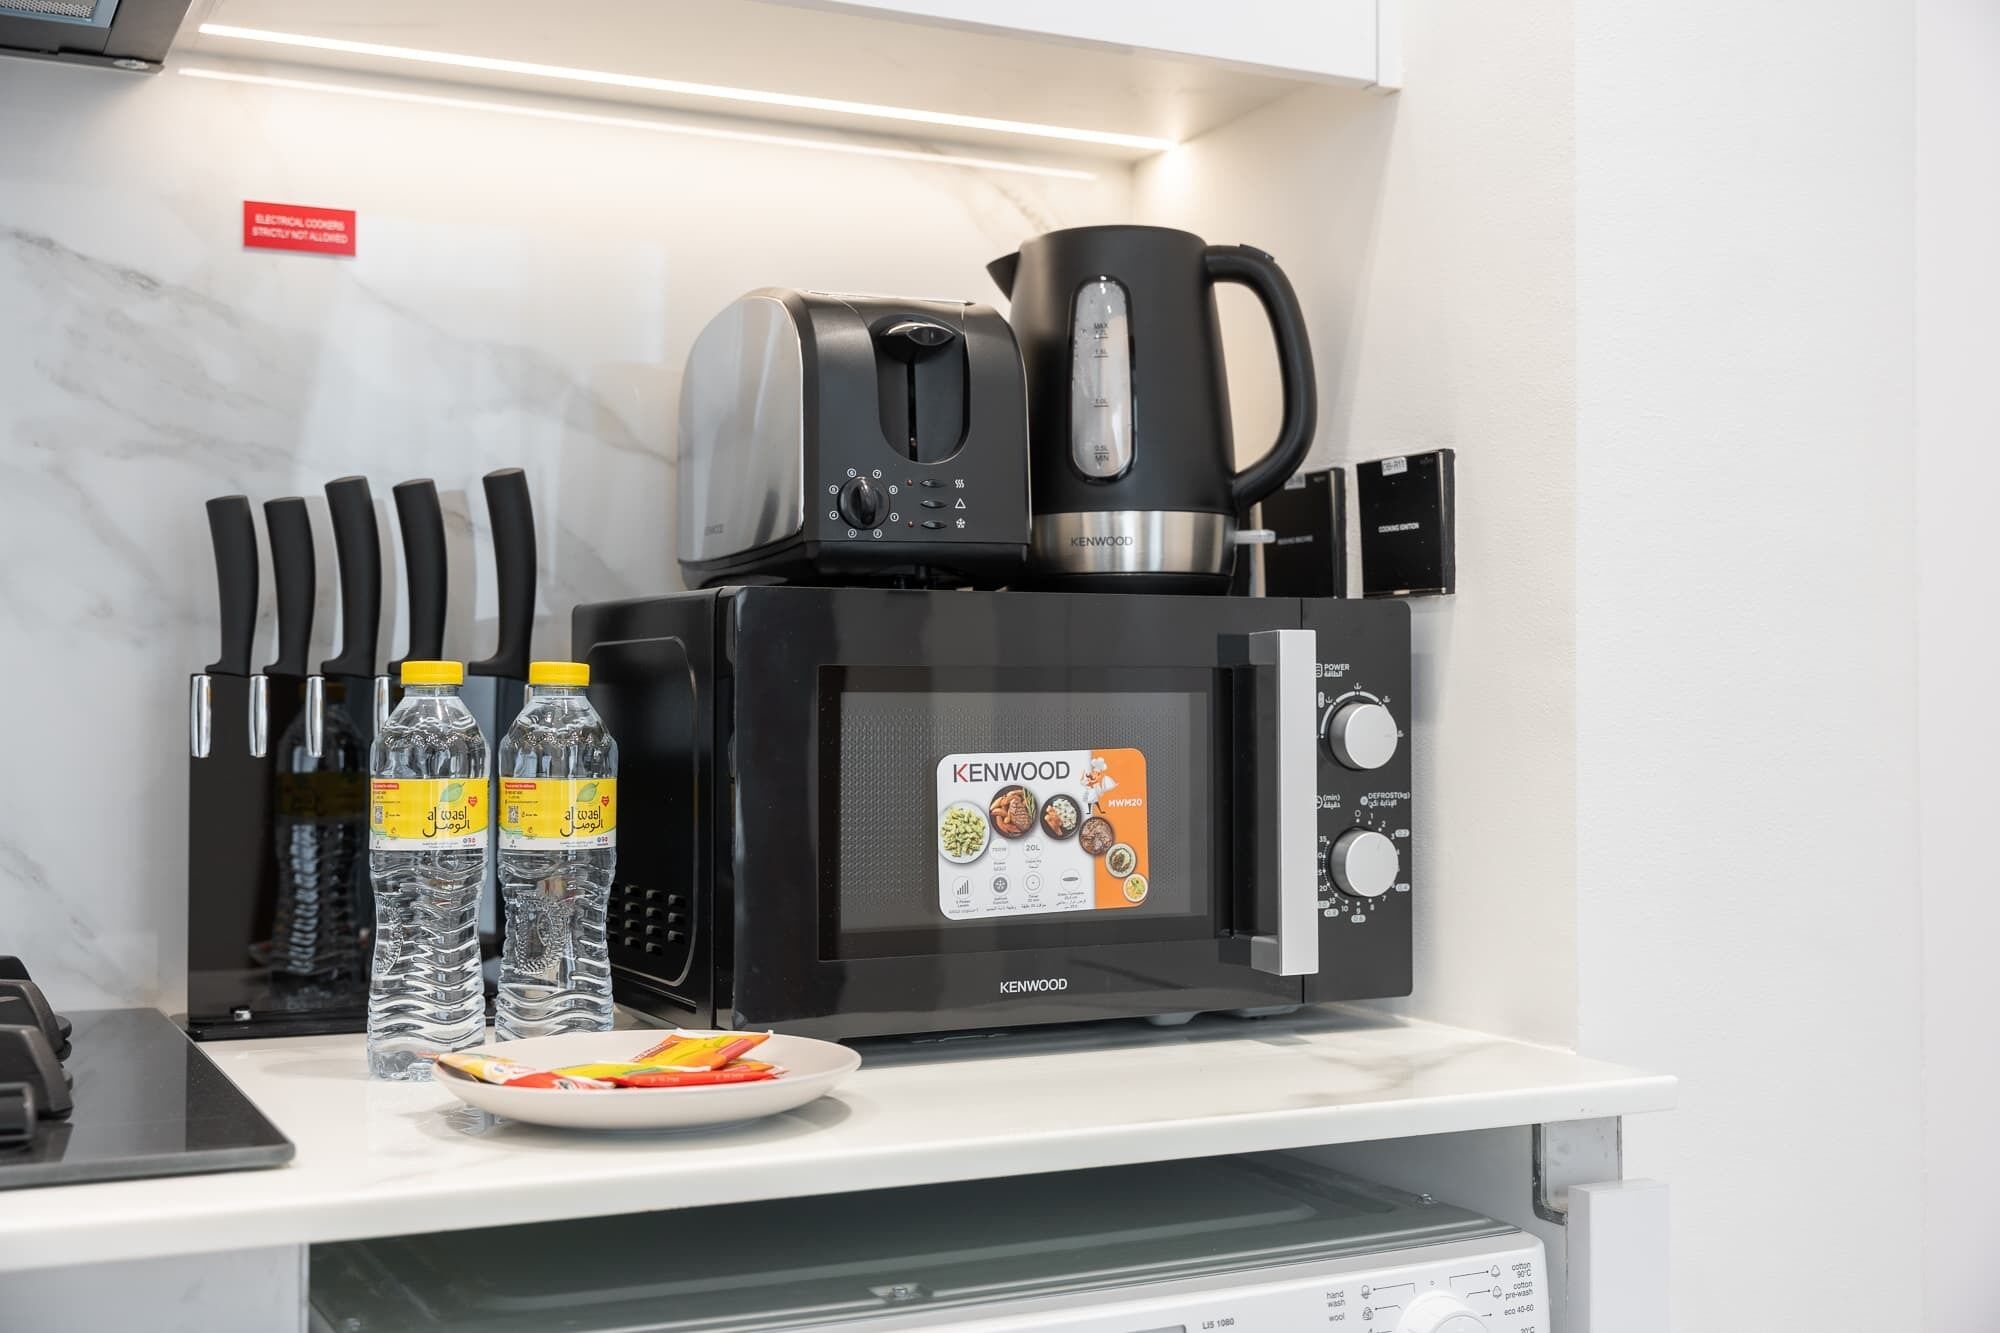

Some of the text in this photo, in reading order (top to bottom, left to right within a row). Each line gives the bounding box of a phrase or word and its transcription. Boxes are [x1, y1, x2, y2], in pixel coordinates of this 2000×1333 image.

[255, 214, 345, 231] ELECTRICAL COOKERS
[252, 227, 348, 244] STRICTLY NOT ALLOWED
[1095, 454, 1109, 462] MIN
[1070, 536, 1133, 547] KENWOOD
[953, 761, 1070, 783] KENWOOD
[1108, 798, 1143, 808] MWM20
[1354, 809, 1362, 817] 0
[1025, 844, 1041, 852] 20L
[1319, 884, 1328, 892] 20
[1000, 978, 1068, 994] KENWOOD
[1511, 1262, 1531, 1271] cotton
[1513, 1281, 1533, 1290] cotton
[1326, 1290, 1345, 1299] hand
[1505, 1288, 1534, 1301] pre-wash
[1328, 1299, 1345, 1307] wash
[1504, 1304, 1535, 1316] eco 40-60
[1217, 1317, 1235, 1327] 1080
[1329, 1312, 1345, 1322] wool
